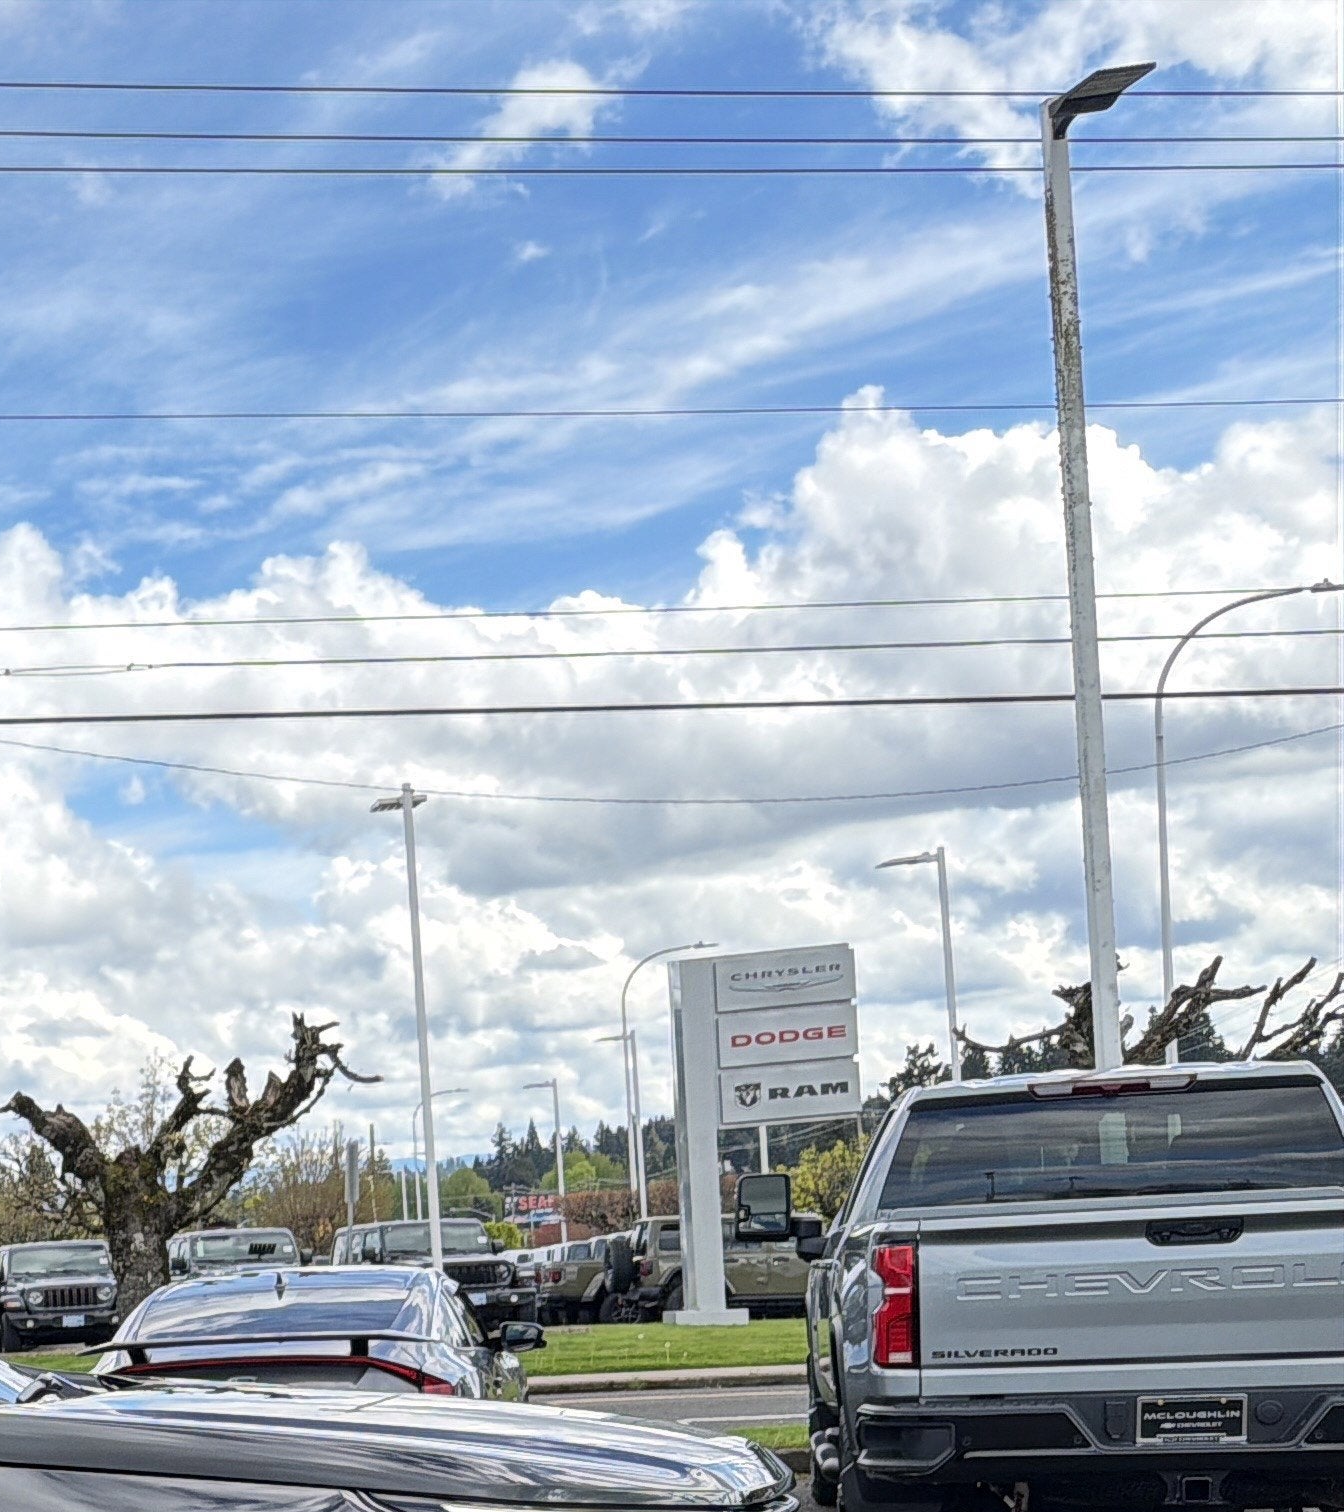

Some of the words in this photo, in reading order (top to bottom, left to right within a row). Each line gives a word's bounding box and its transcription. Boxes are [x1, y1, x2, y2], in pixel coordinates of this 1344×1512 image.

[730, 962, 842, 982] CHRYSLER
[730, 1024, 847, 1048] DODGE
[768, 1081, 850, 1100] RAM
[956, 1263, 1344, 1301] CHEVROL
[931, 1346, 1059, 1360] SILVERADO
[1144, 1410, 1241, 1420] MCLOUGHLIN
